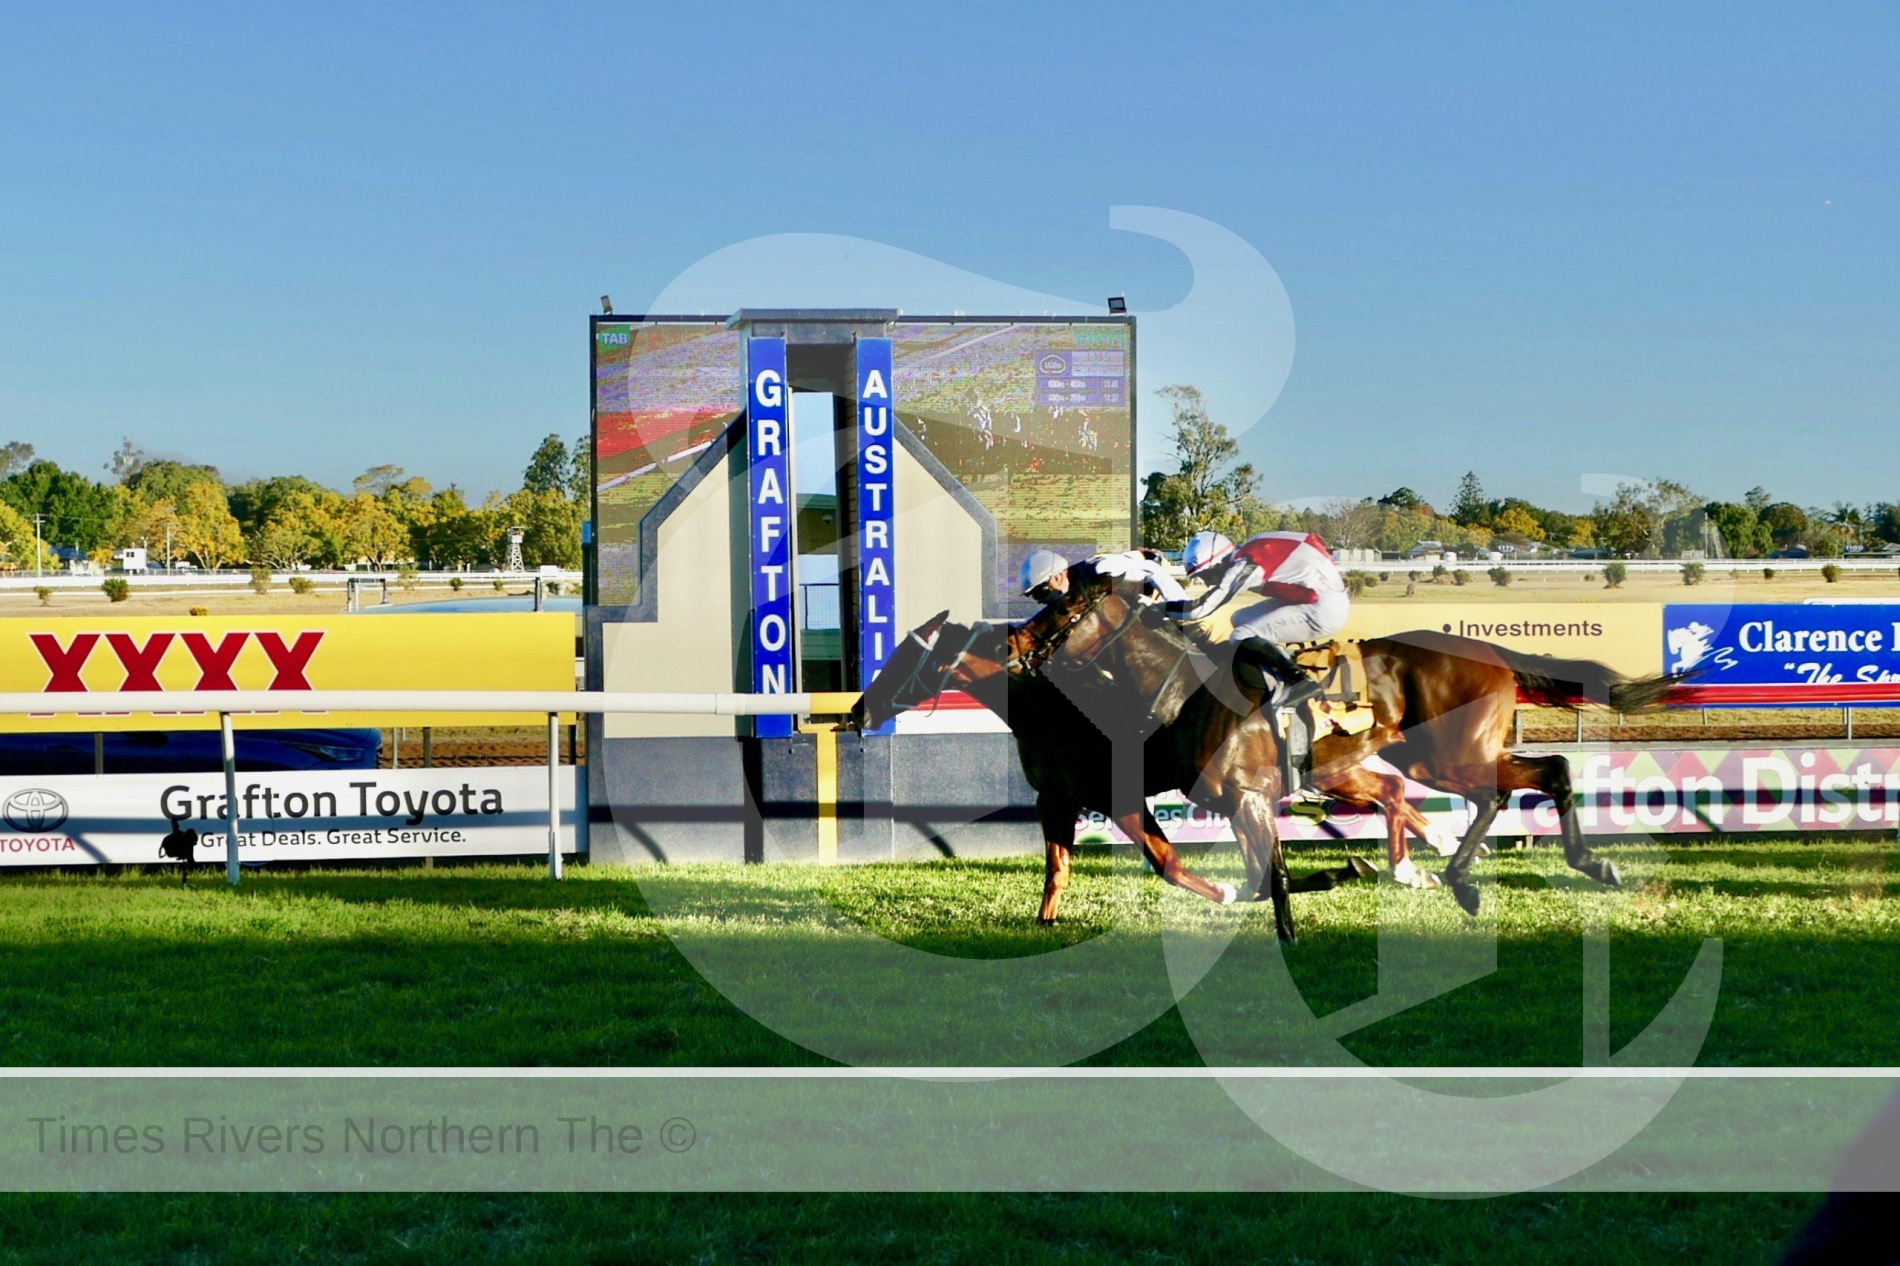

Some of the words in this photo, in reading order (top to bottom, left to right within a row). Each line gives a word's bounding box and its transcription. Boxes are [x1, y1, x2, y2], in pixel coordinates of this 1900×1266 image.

[602, 333, 628, 345] TAB
[755, 369, 787, 694] GRAFTON
[862, 369, 891, 683] AUSTRALI
[1459, 620, 1603, 637] Investments
[1739, 620, 1883, 653] Clarence
[28, 631, 328, 716] XXXX
[160, 783, 338, 821] Grafton
[349, 781, 504, 826] Toyota
[0, 837, 76, 852] TOYOTA
[201, 831, 256, 847] Grat
[261, 829, 322, 846] Deals.
[326, 829, 382, 844] Great
[387, 826, 466, 844] Service.
